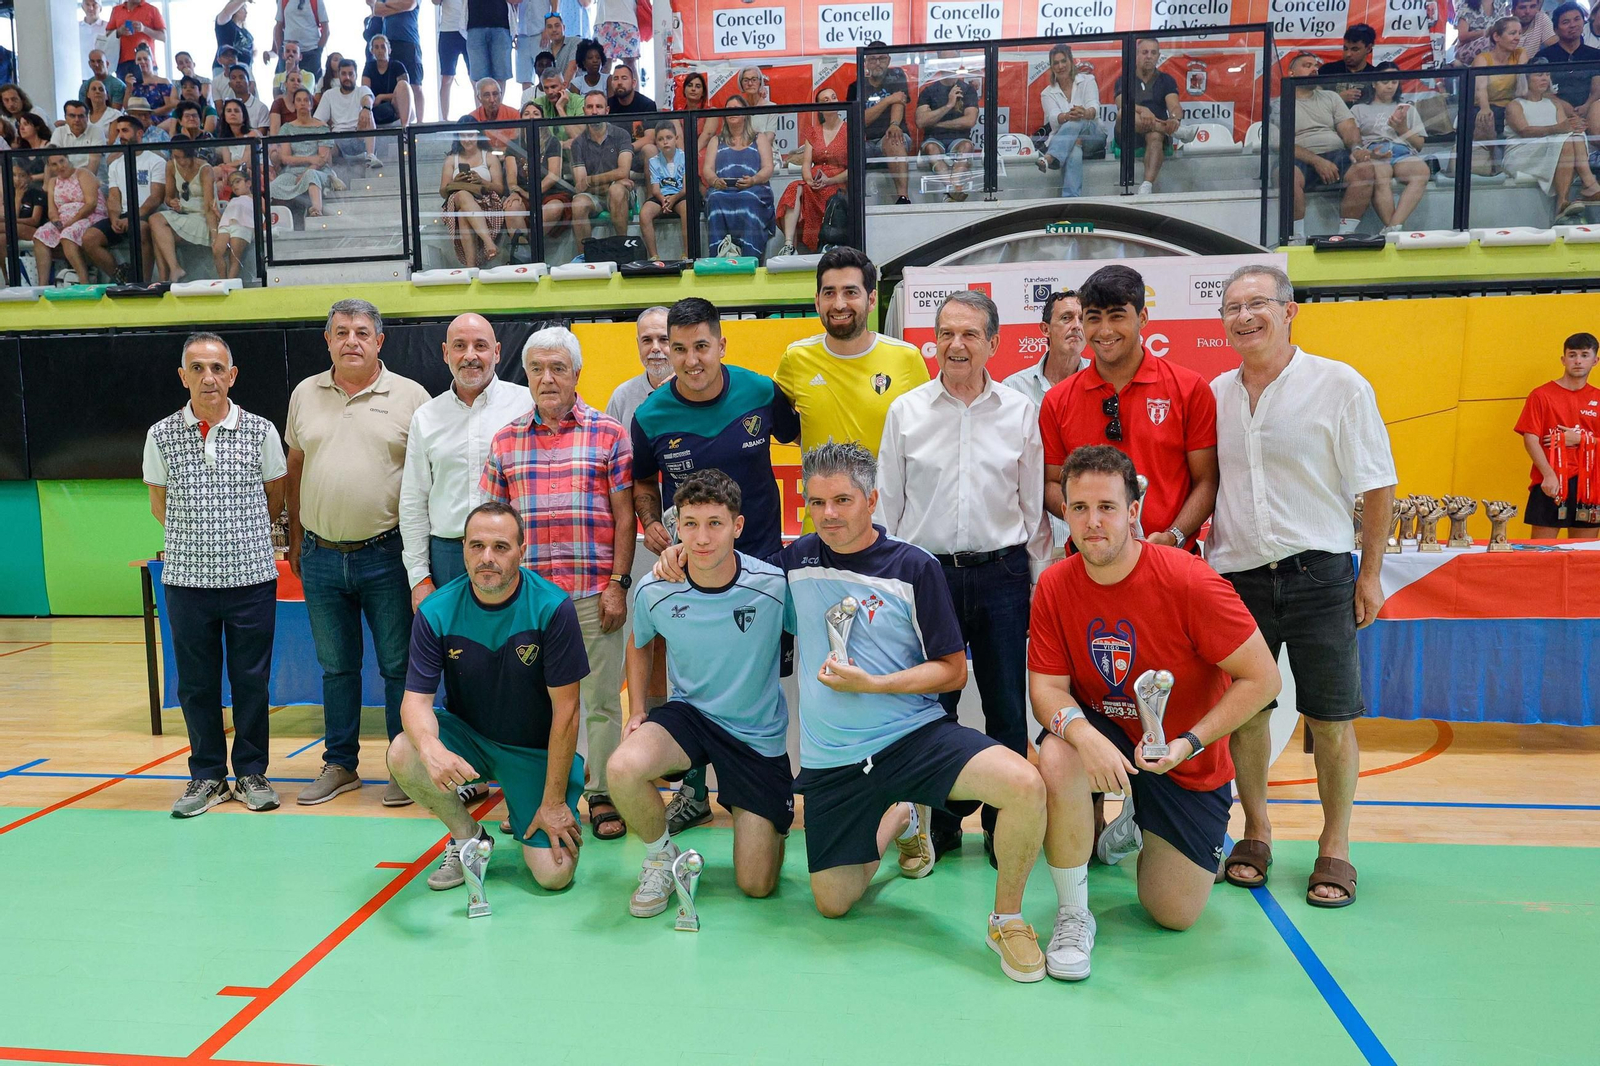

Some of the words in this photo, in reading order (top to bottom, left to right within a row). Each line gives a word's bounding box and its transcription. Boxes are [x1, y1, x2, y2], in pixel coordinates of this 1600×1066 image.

[821, 5, 890, 23] Concello
[930, 3, 1000, 20] Concello
[1041, 1, 1113, 18] Concello
[1155, 0, 1228, 15] Concello
[1272, 0, 1346, 12] Concello
[716, 10, 782, 27] Concello
[1275, 17, 1294, 33] de
[1300, 16, 1335, 37] Vigo
[1391, 15, 1412, 31] de
[826, 27, 844, 42] de
[848, 26, 882, 46] Vigo
[934, 24, 952, 39] de
[957, 24, 991, 42] Vigo
[1044, 22, 1063, 37] de
[721, 32, 738, 47] de
[742, 30, 775, 50] Vigo
[1182, 104, 1231, 120] ncello
[913, 290, 952, 299] CONCEL
[1200, 290, 1213, 299] DE
[919, 300, 931, 308] DE
[1197, 338, 1224, 348] FARO
[1103, 706, 1138, 717] 2023-24
